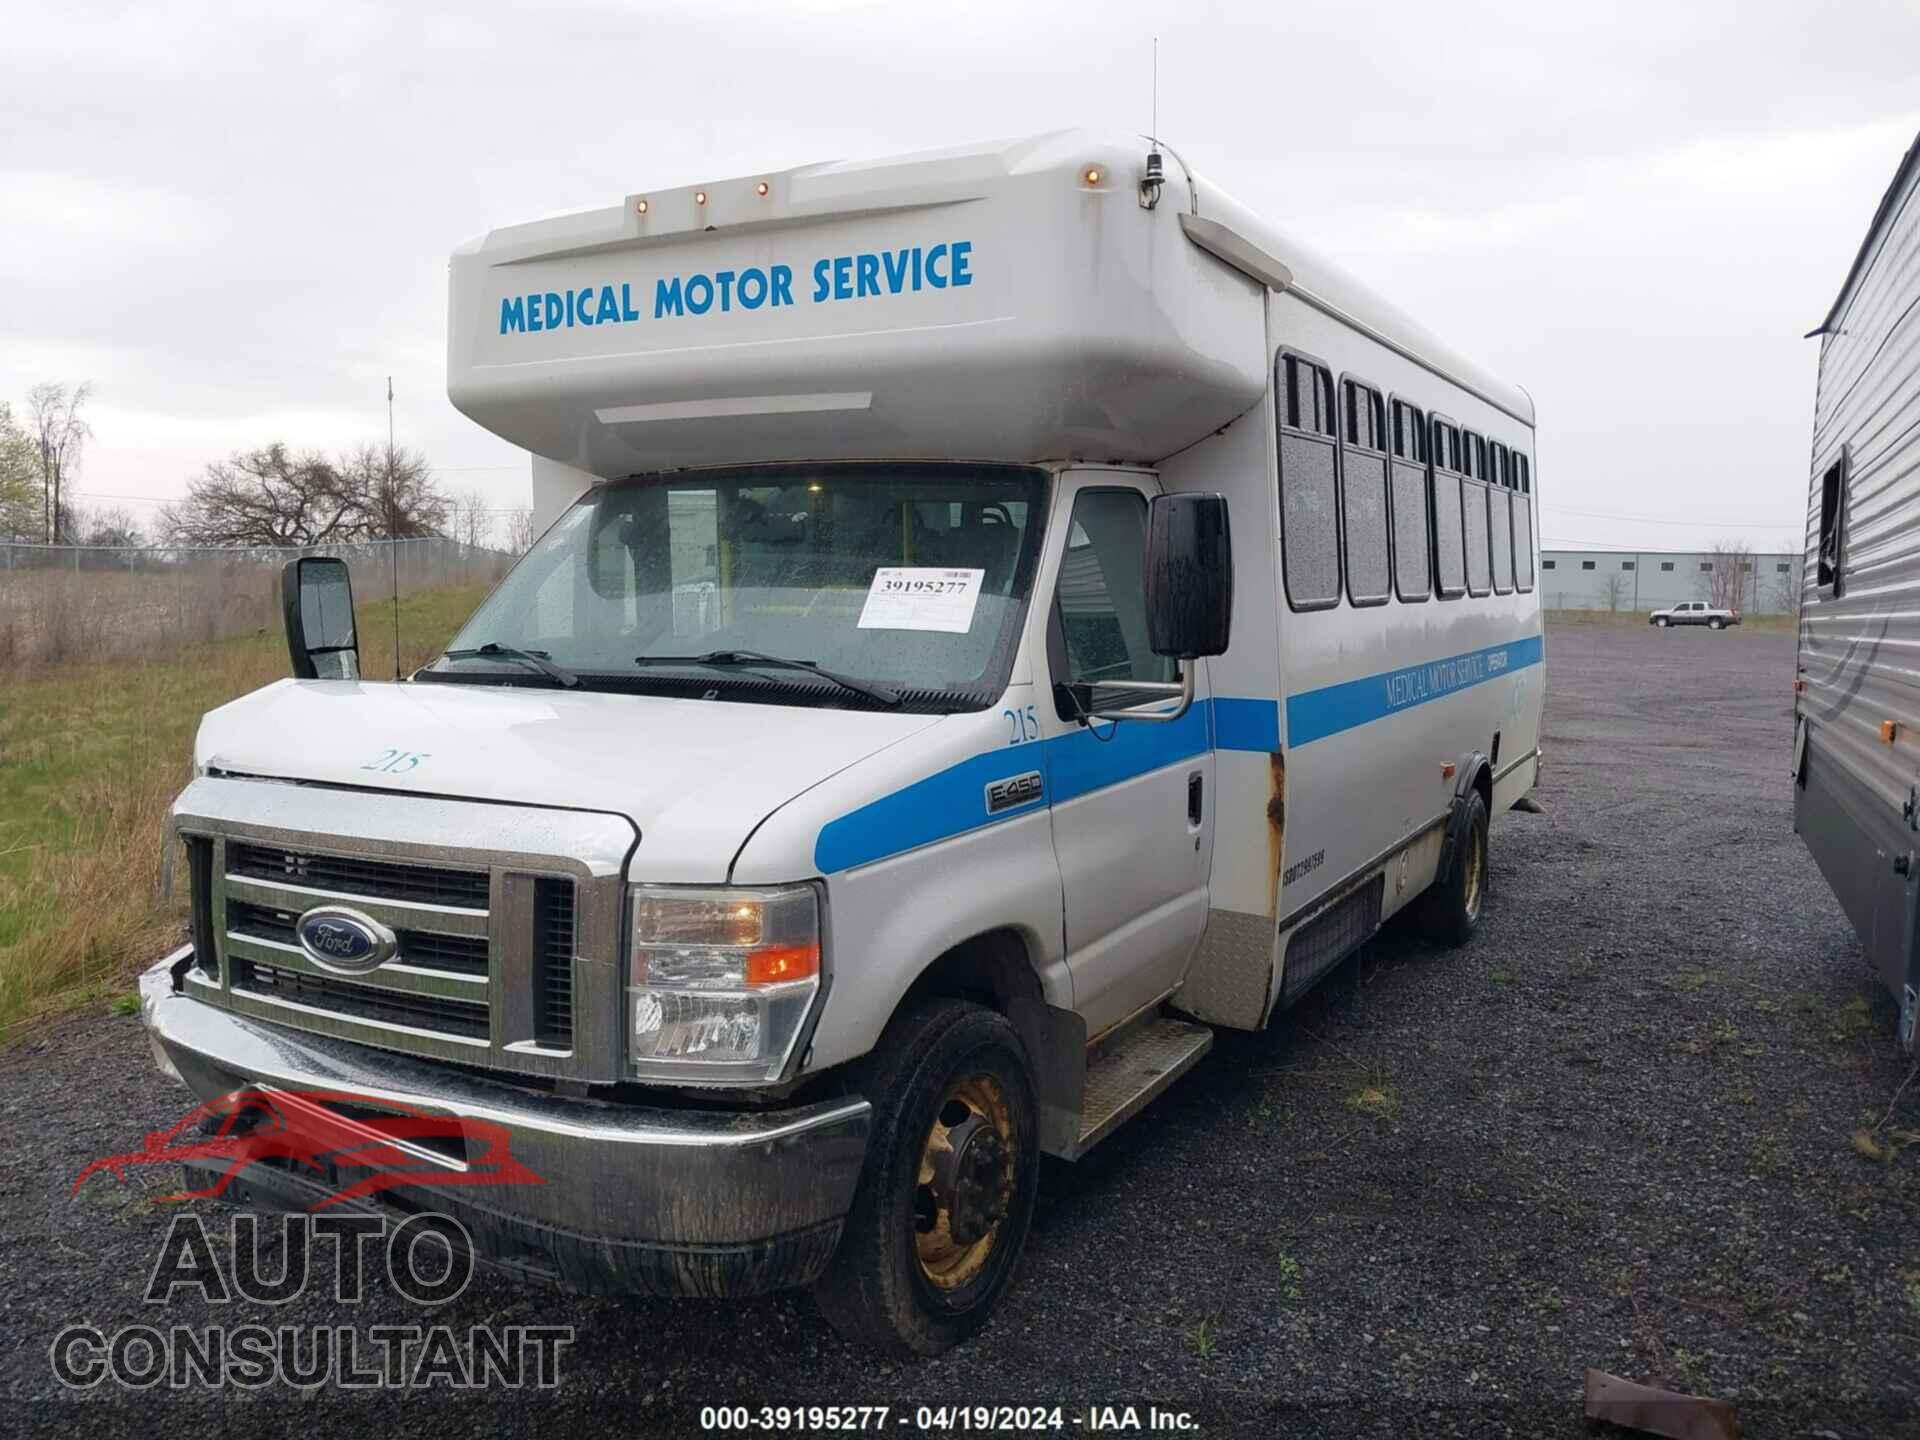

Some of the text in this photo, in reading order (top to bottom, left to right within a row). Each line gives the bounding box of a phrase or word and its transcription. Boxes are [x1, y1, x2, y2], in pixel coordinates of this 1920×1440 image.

[500, 240, 974, 334] MEDICAL MOTOR SERVICE
[880, 580, 968, 594] 39195277
[1385, 669, 1429, 708] MEDICAL
[1003, 705, 1039, 745] 215
[360, 749, 432, 774] 215
[314, 922, 355, 954] Ford
